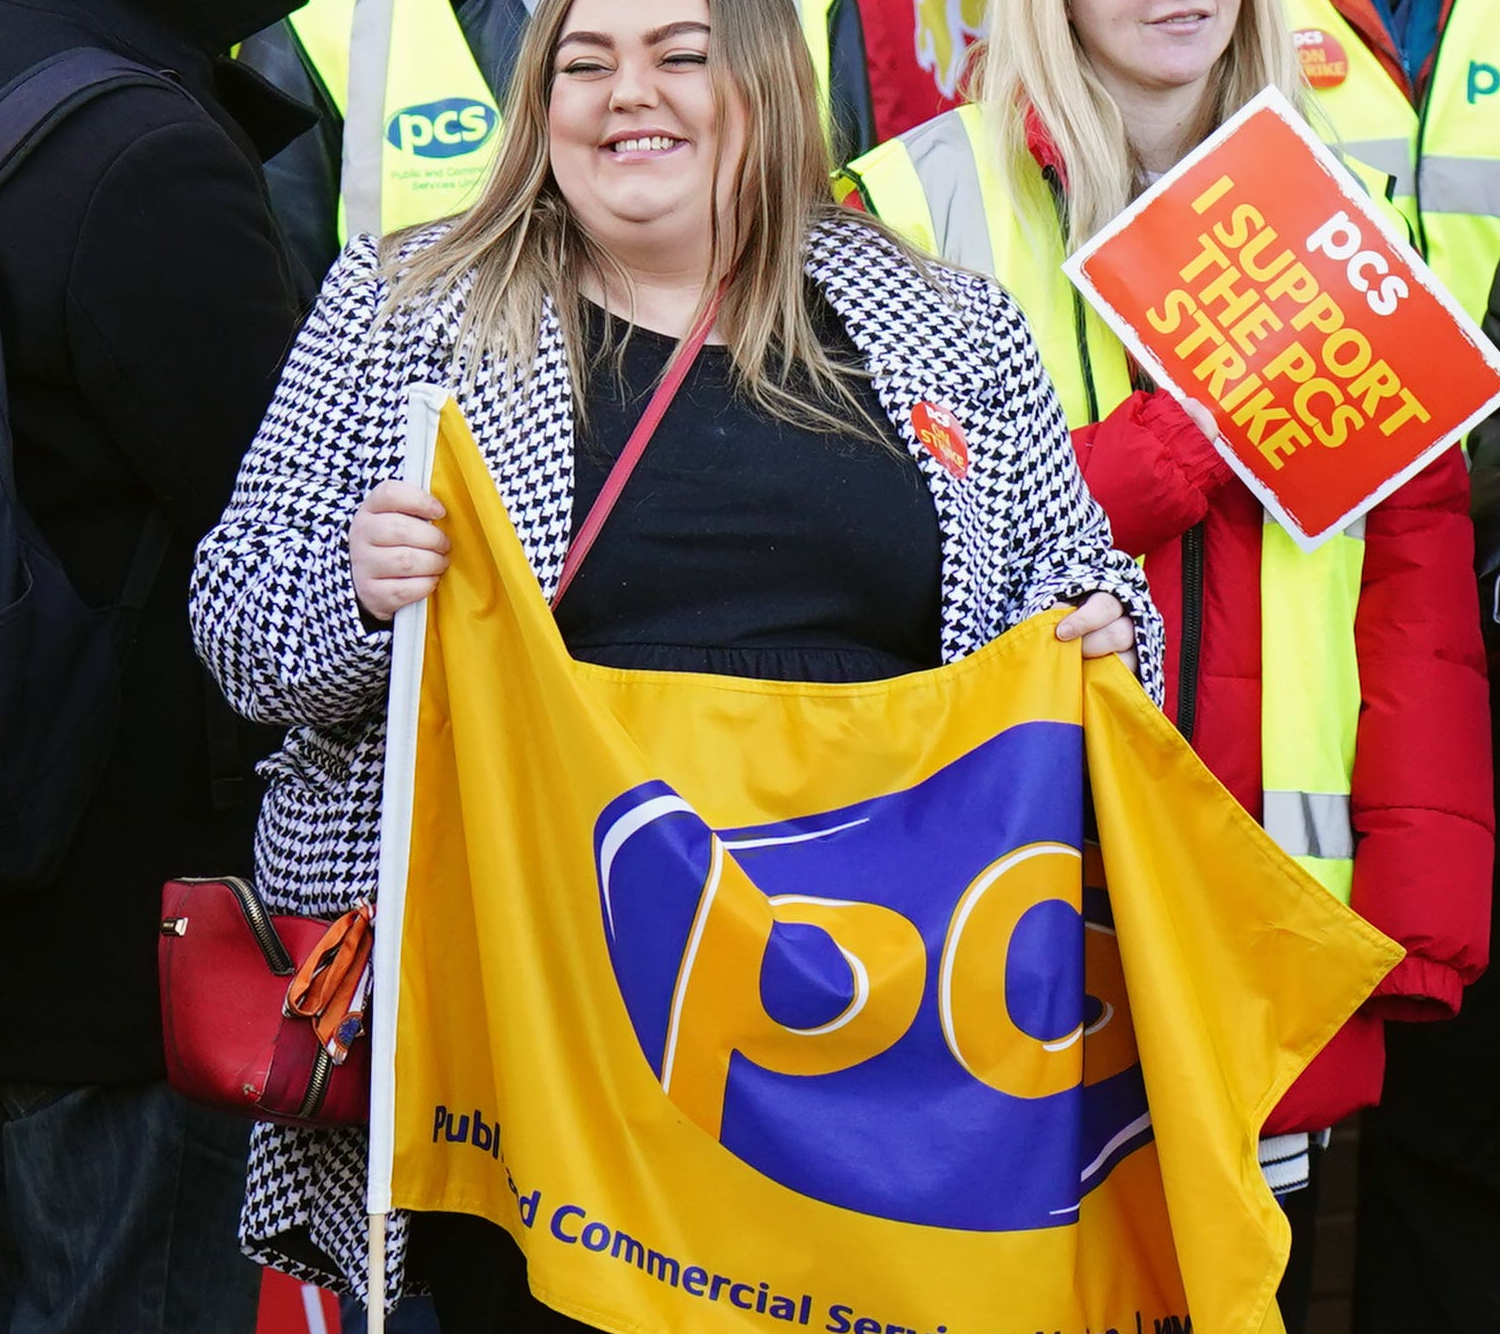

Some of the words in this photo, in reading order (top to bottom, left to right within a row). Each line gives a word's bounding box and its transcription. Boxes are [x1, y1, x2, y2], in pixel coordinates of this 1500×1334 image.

[398, 105, 489, 155] pcs
[1190, 174, 1235, 215] I
[1213, 203, 1431, 437] SUPPORT
[1306, 210, 1409, 316] pcs
[1145, 288, 1313, 471] STRIKE
[1178, 232, 1284, 357] THE
[1261, 340, 1365, 449] PCS
[549, 1203, 813, 1326] Commercial
